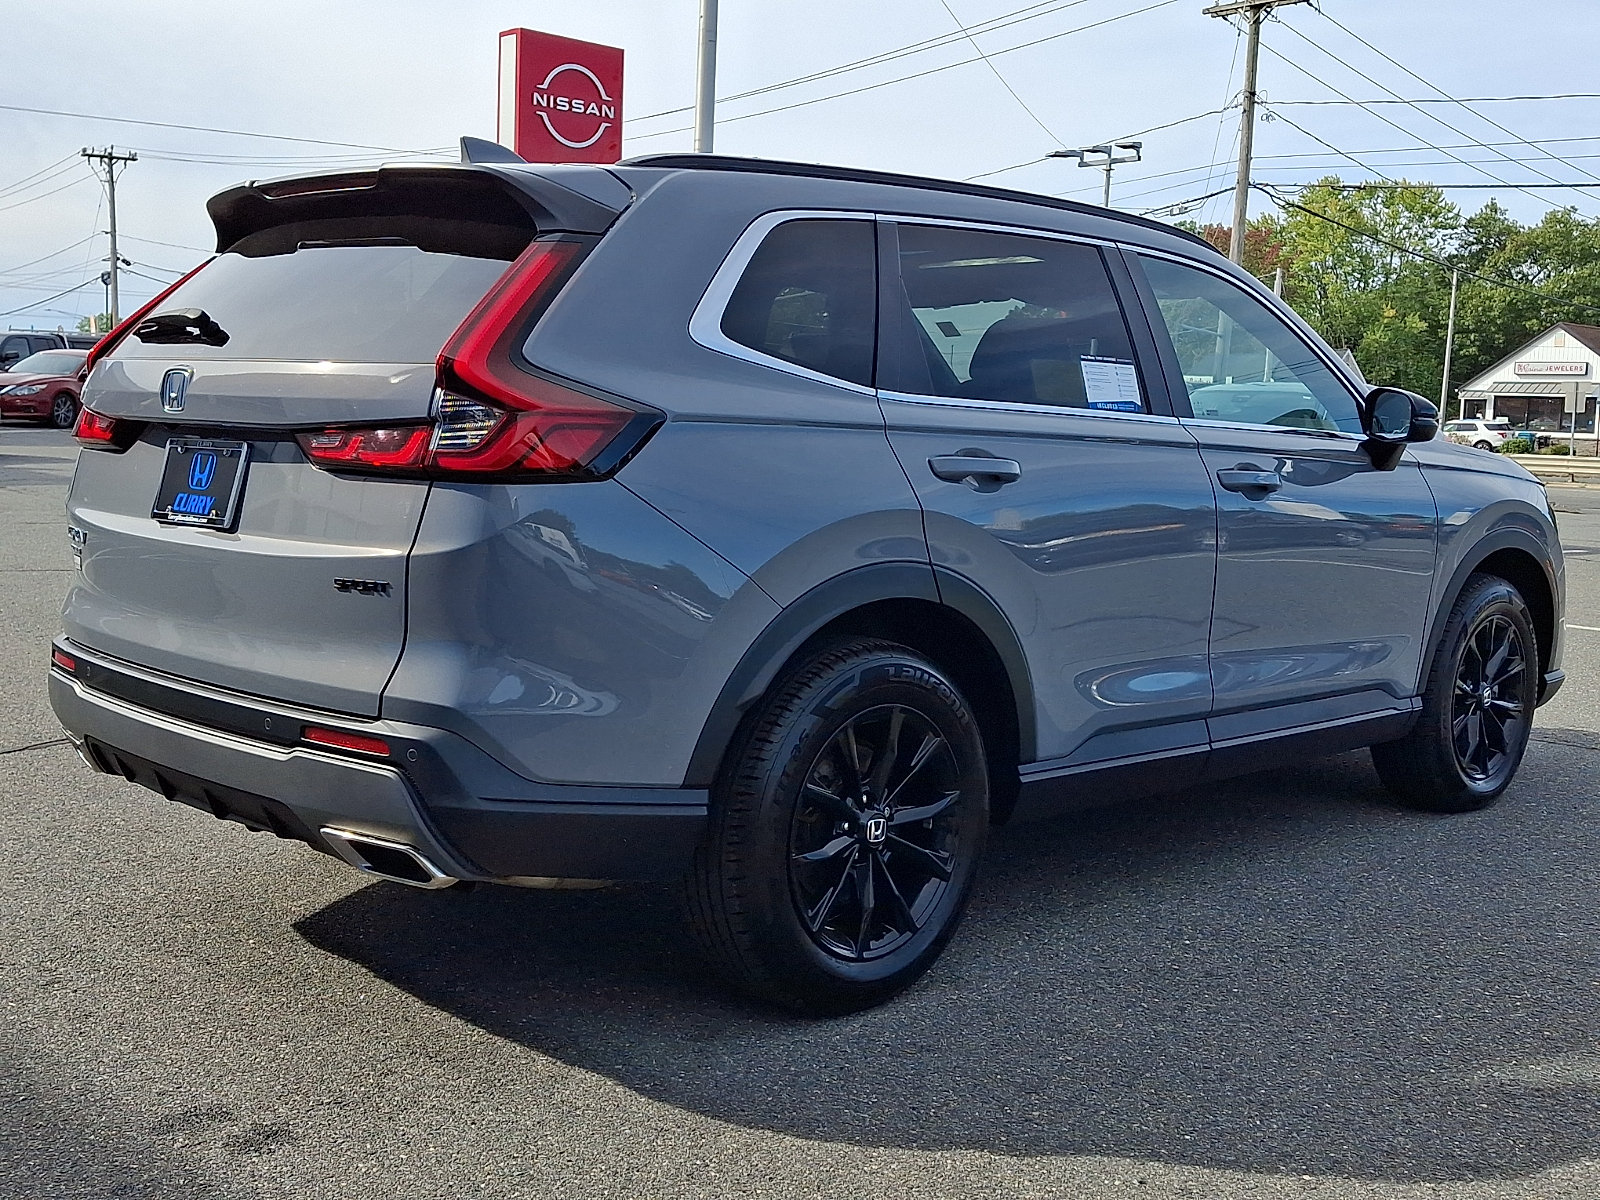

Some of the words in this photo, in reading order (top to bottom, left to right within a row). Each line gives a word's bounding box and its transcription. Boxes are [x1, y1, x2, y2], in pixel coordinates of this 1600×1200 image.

[532, 91, 615, 119] NISSAN
[173, 493, 215, 515] CURRY
[333, 576, 394, 598] SPORT
